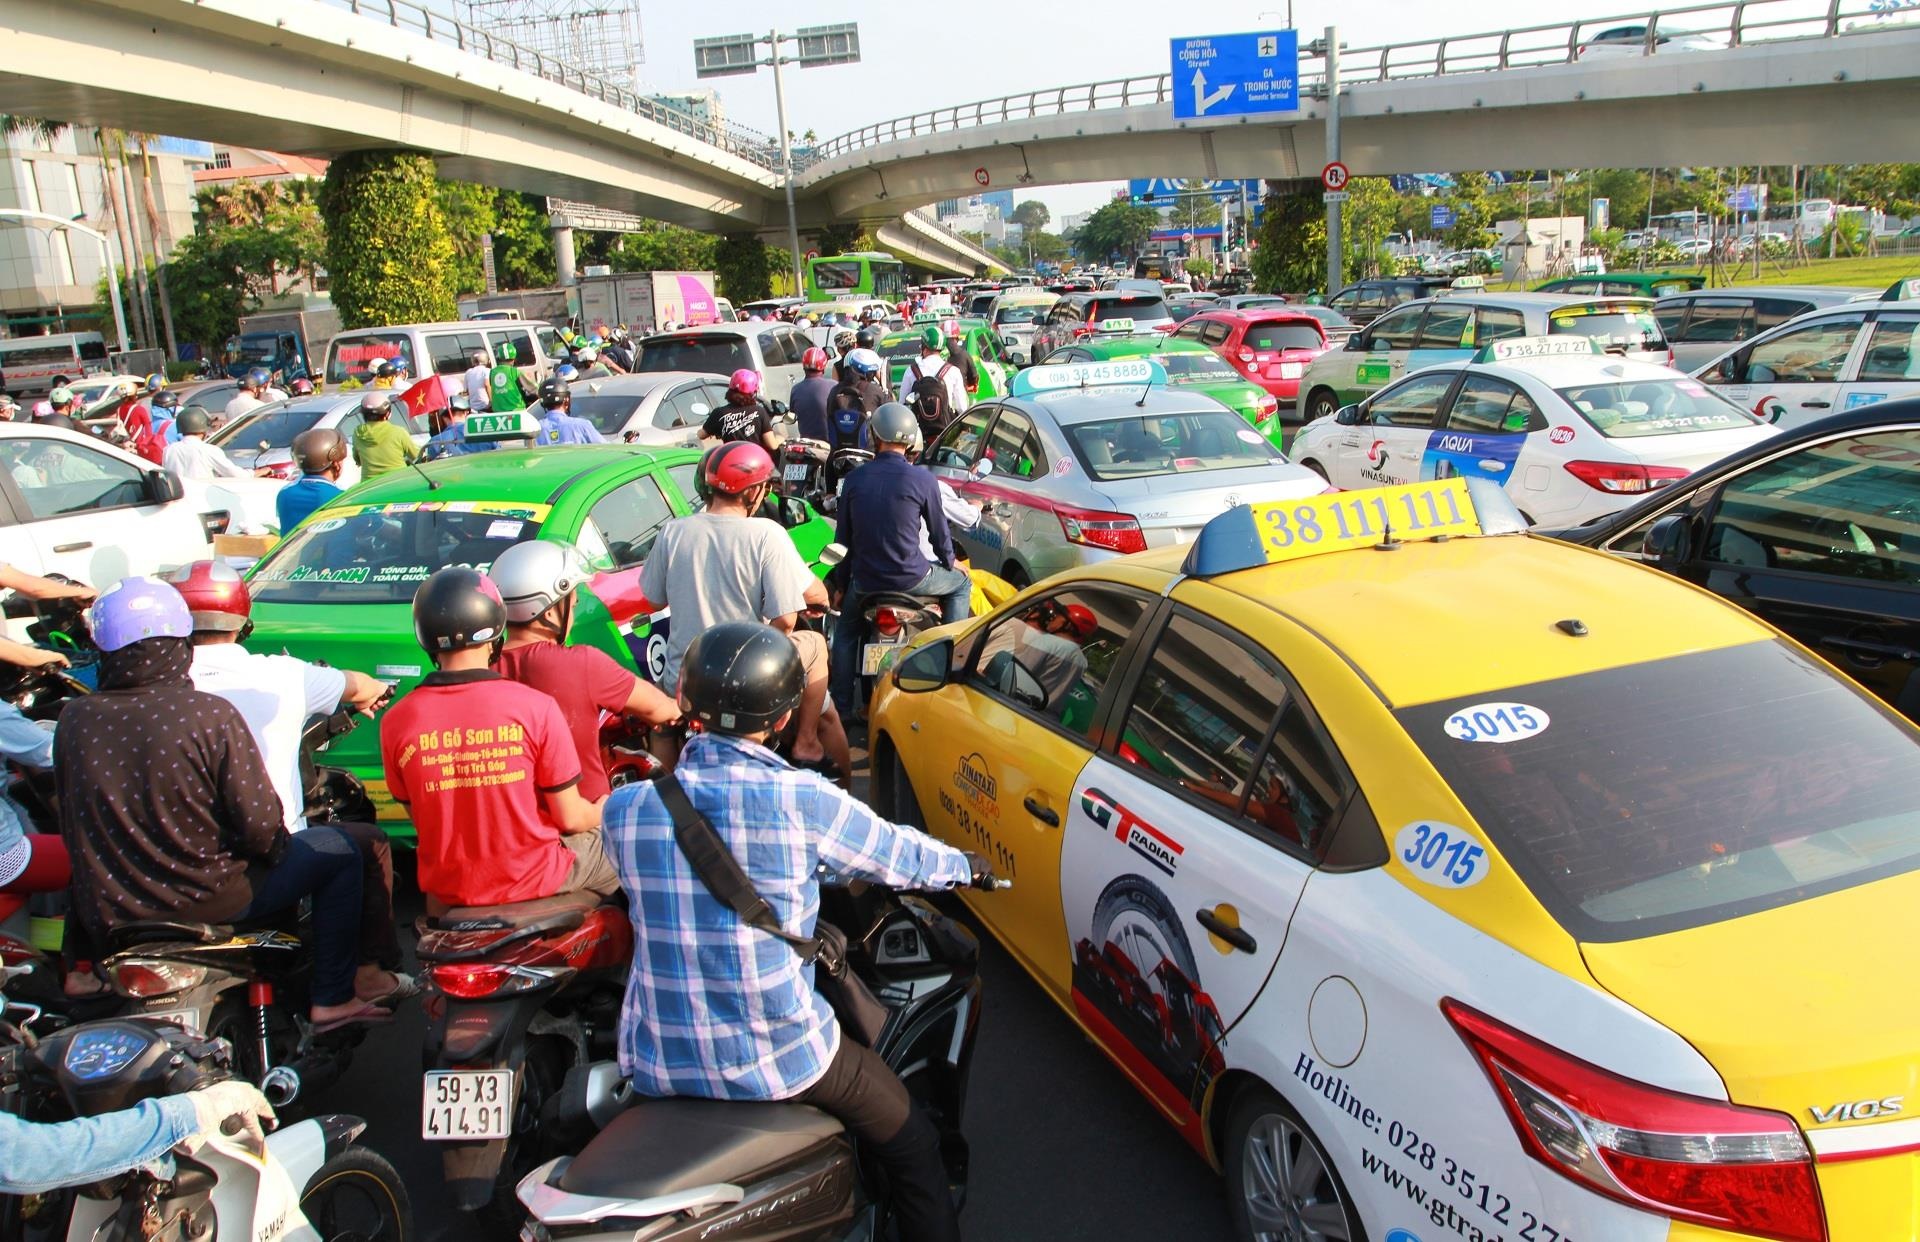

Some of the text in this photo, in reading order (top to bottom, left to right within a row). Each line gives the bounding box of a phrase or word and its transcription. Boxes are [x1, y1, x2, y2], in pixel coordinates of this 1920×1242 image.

[1179, 47, 1217, 60] CỘNG HÒA
[1188, 60, 1209, 68] Street
[1244, 77, 1292, 92] TRONG NƯỚC
[1263, 68, 1273, 78] GA
[1555, 342, 1569, 352] 27
[1573, 341, 1587, 351] 27
[1049, 364, 1148, 383] (08) 38 45 8888
[1439, 435, 1473, 453] AQUA
[1265, 487, 1465, 548] 38 111 111
[373, 574, 399, 582] TOÀN
[381, 566, 406, 574] TỔNG
[420, 724, 523, 750] Đồ Gỗ Sơn Hải
[1451, 706, 1538, 742] 3015
[957, 803, 971, 834] 38
[974, 820, 992, 856] 111
[996, 841, 1016, 877] 111
[1131, 829, 1176, 868] RADIAL
[1404, 824, 1484, 884] 3015
[437, 1076, 498, 1104] 59-X3
[428, 1106, 502, 1135] 414.91
[1809, 1095, 1904, 1124] VIOS
[1293, 1051, 1574, 1242] Hotline: 028 3512 27
